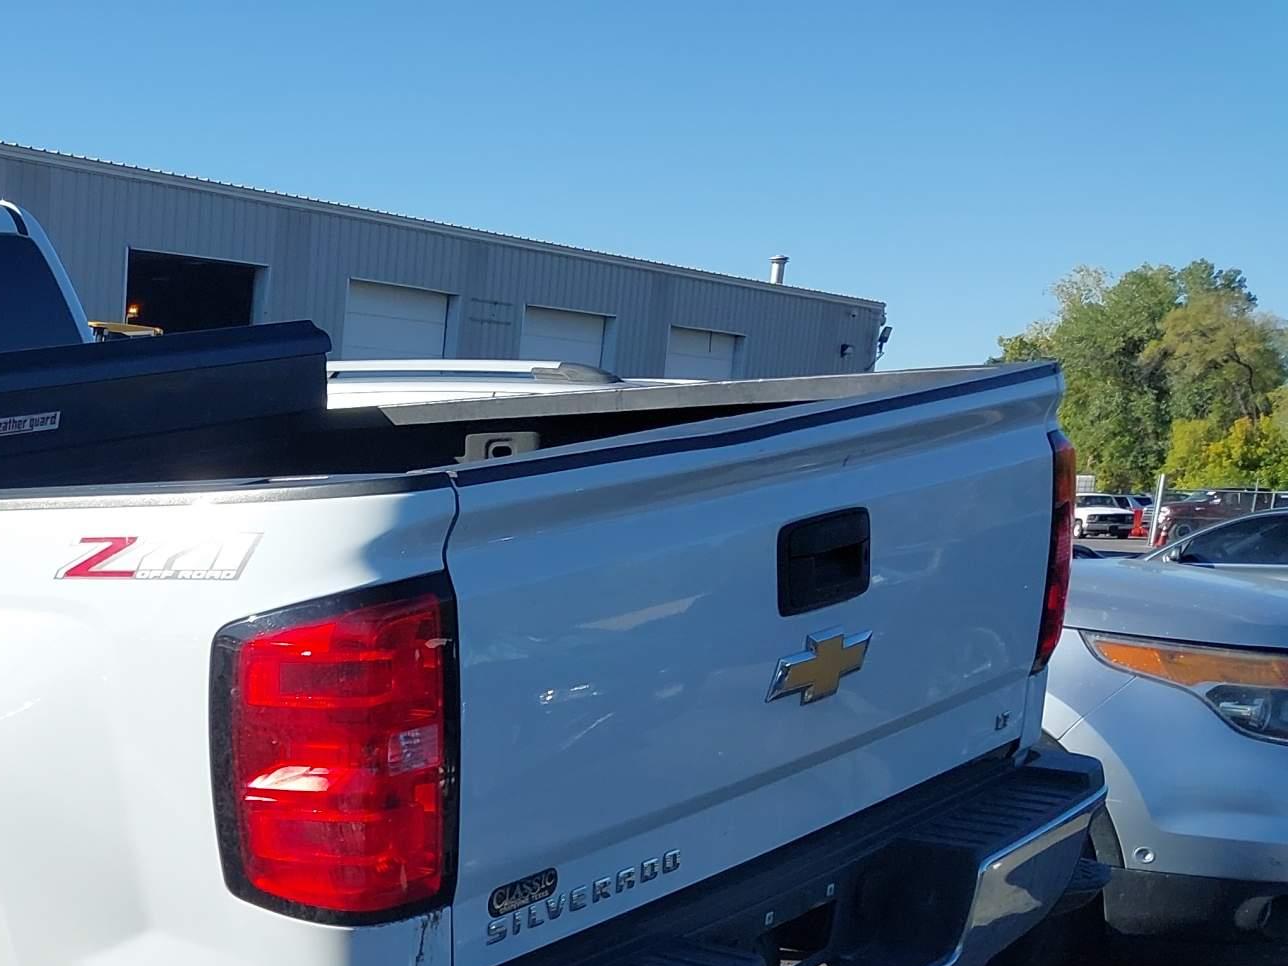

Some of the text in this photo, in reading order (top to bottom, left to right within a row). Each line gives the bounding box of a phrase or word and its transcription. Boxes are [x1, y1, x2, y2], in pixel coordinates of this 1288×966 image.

[29, 413, 57, 430] guard
[136, 569, 237, 580] OFF ROAD
[485, 849, 681, 946] SILVERADO
[493, 870, 555, 910] CLASSIC
